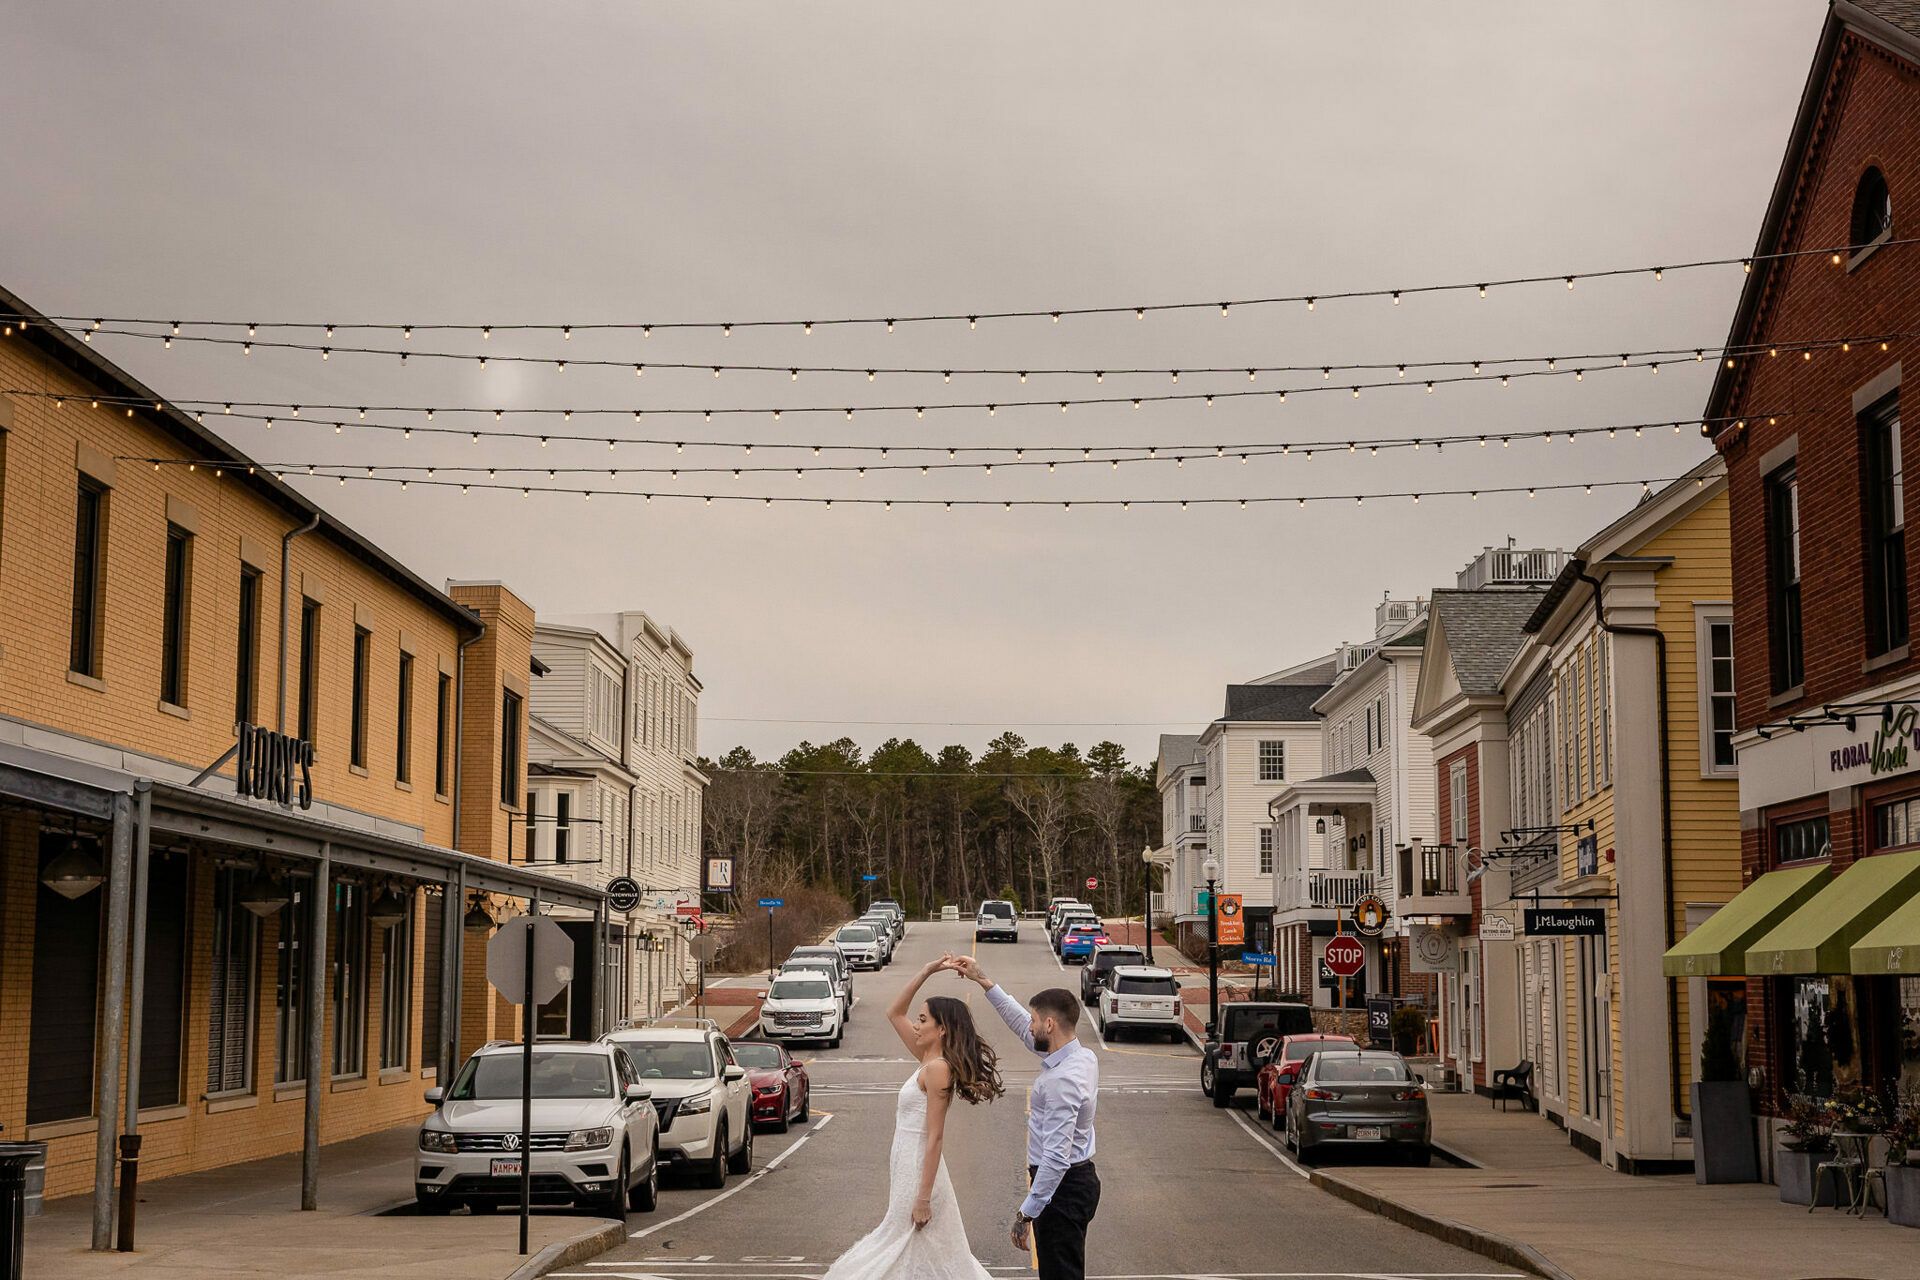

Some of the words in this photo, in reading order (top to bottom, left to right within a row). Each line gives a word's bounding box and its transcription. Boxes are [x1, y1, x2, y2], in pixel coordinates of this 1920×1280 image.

[1830, 742, 1872, 772] FLORAL
[1871, 716, 1910, 775] Verde
[237, 721, 313, 810] RORY'S
[1357, 895, 1370, 906] CAPE
[1371, 895, 1383, 906] COD
[1328, 948, 1362, 963] STOP
[1372, 1011, 1389, 1026] 53
